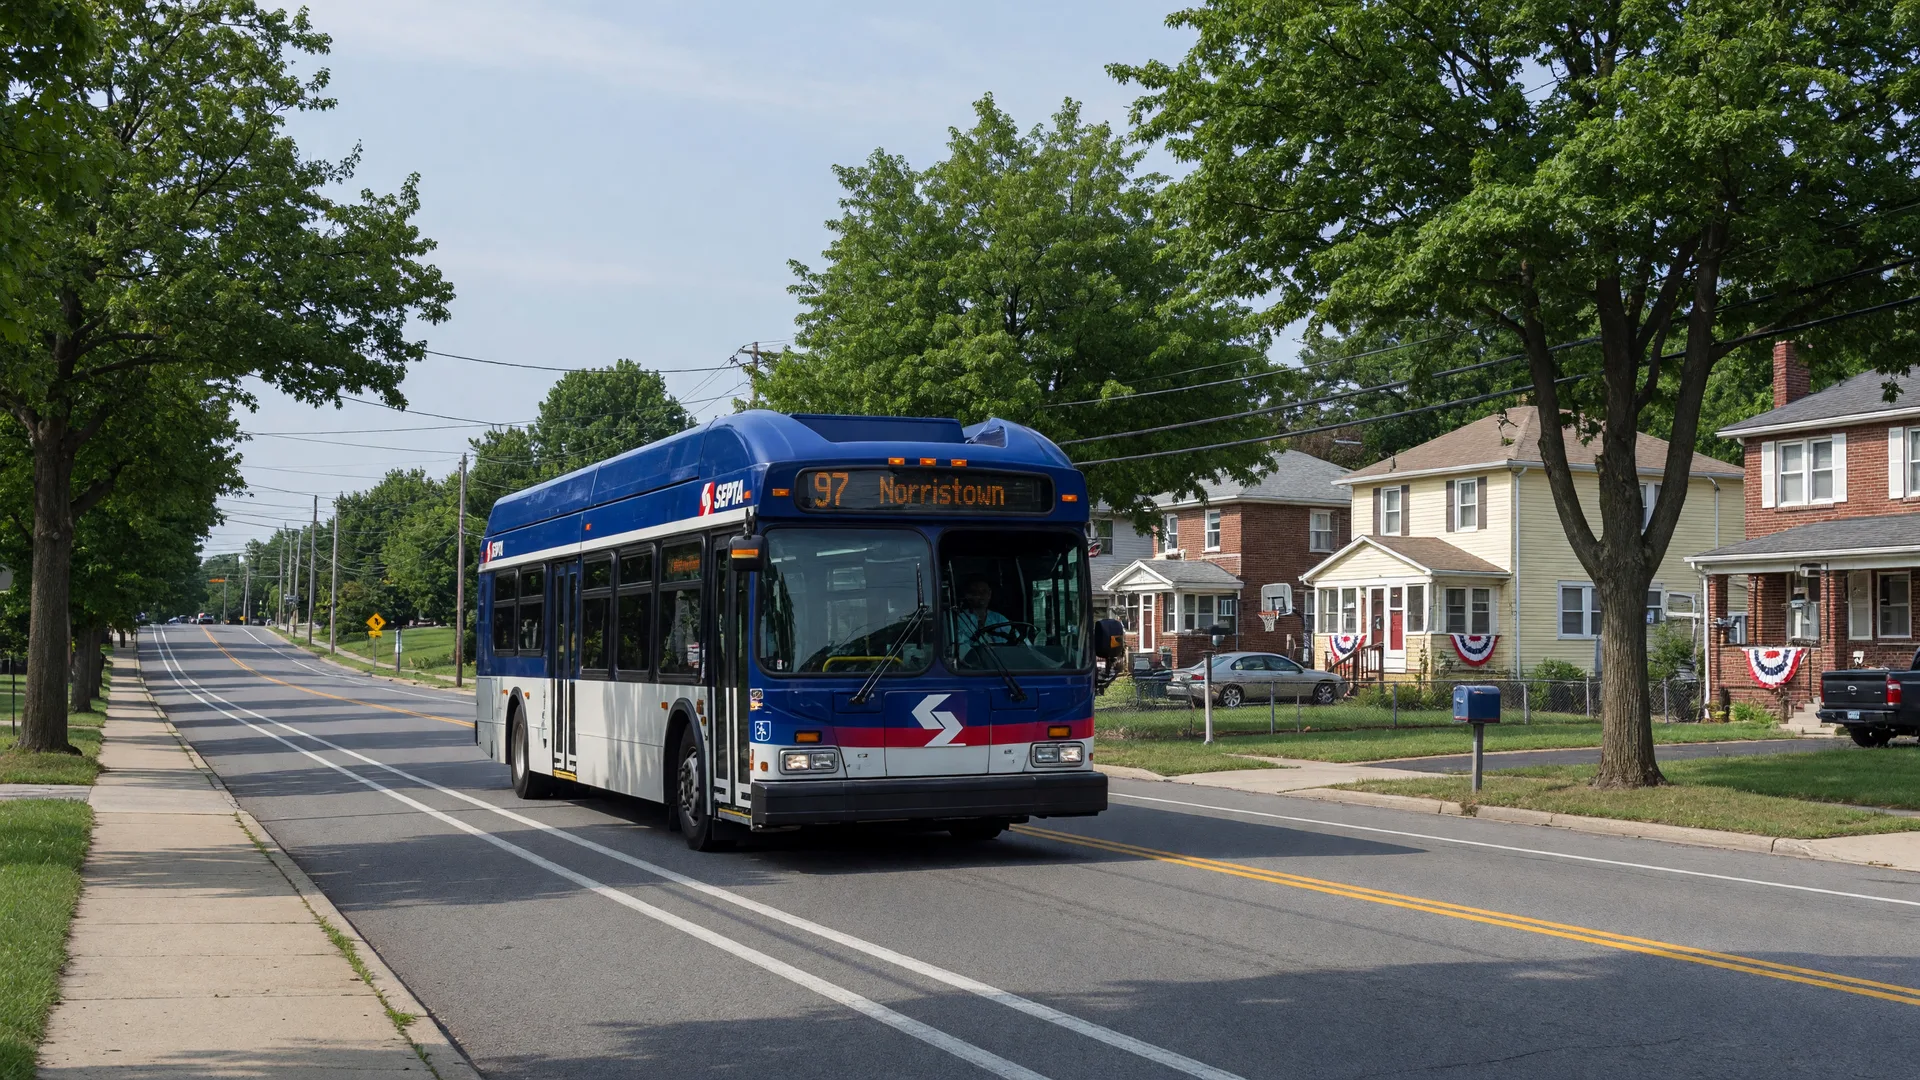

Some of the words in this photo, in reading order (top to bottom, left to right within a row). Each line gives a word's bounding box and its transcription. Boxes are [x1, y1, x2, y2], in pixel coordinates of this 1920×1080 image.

[714, 479, 743, 509] SEPTA
[814, 472, 849, 507] 97
[879, 475, 1005, 506] Norristown
